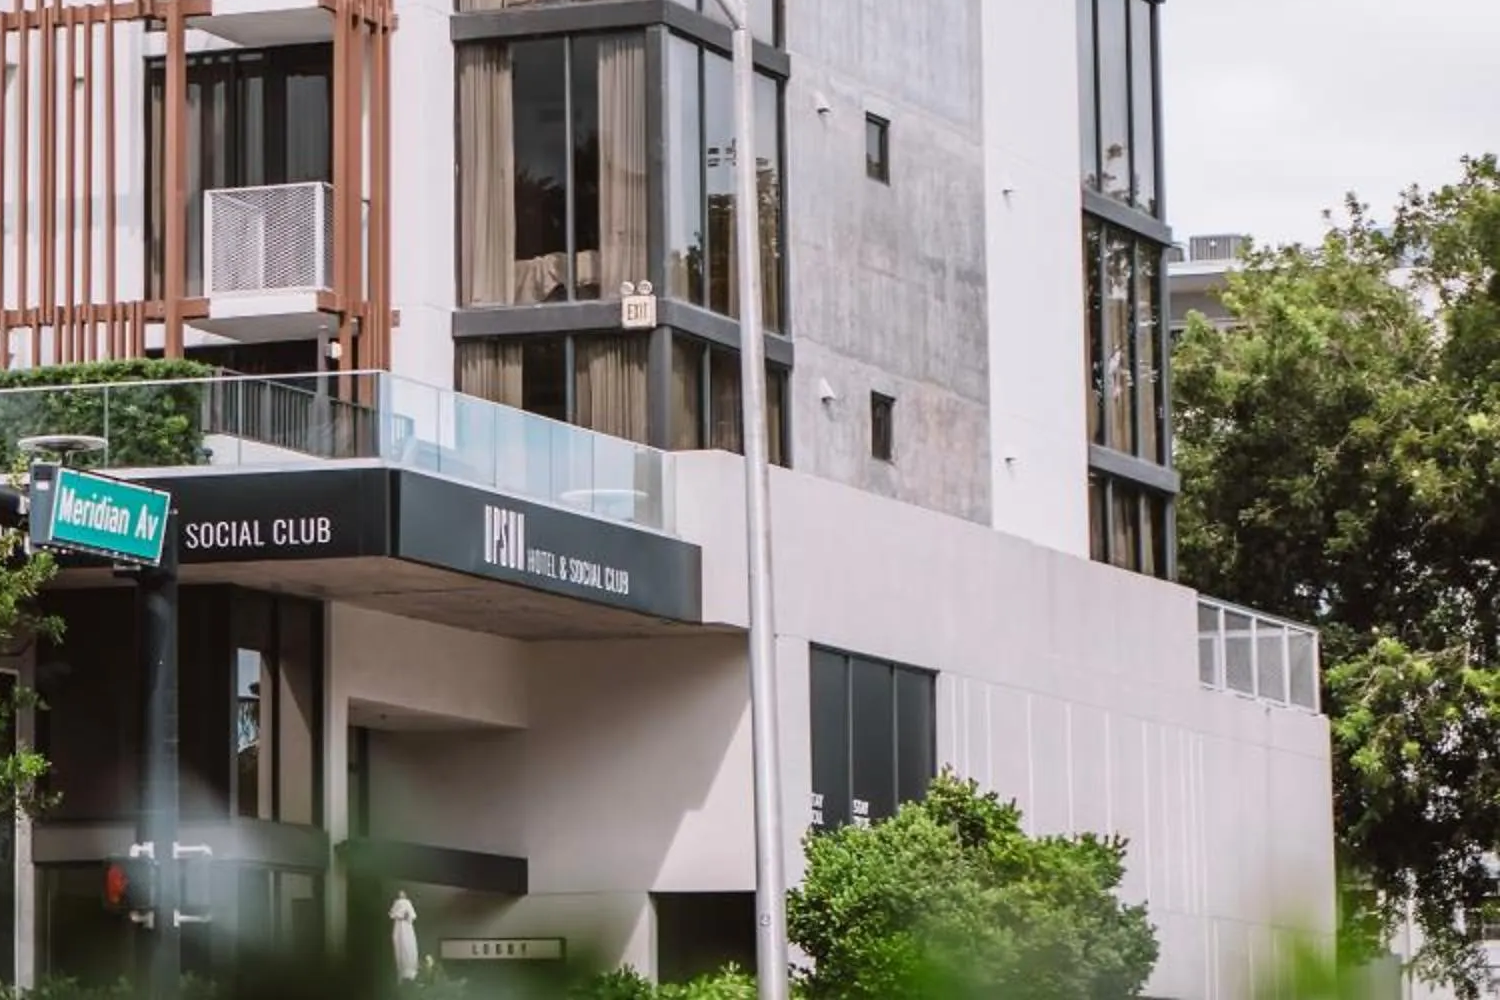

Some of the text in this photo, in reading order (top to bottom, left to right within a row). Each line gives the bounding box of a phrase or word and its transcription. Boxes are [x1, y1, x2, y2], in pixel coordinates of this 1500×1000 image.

[58, 485, 159, 541] Meridian Av
[185, 516, 331, 549] SOCIAL CLUB
[526, 549, 629, 595] HOTEL & SOCIAL CLUB
